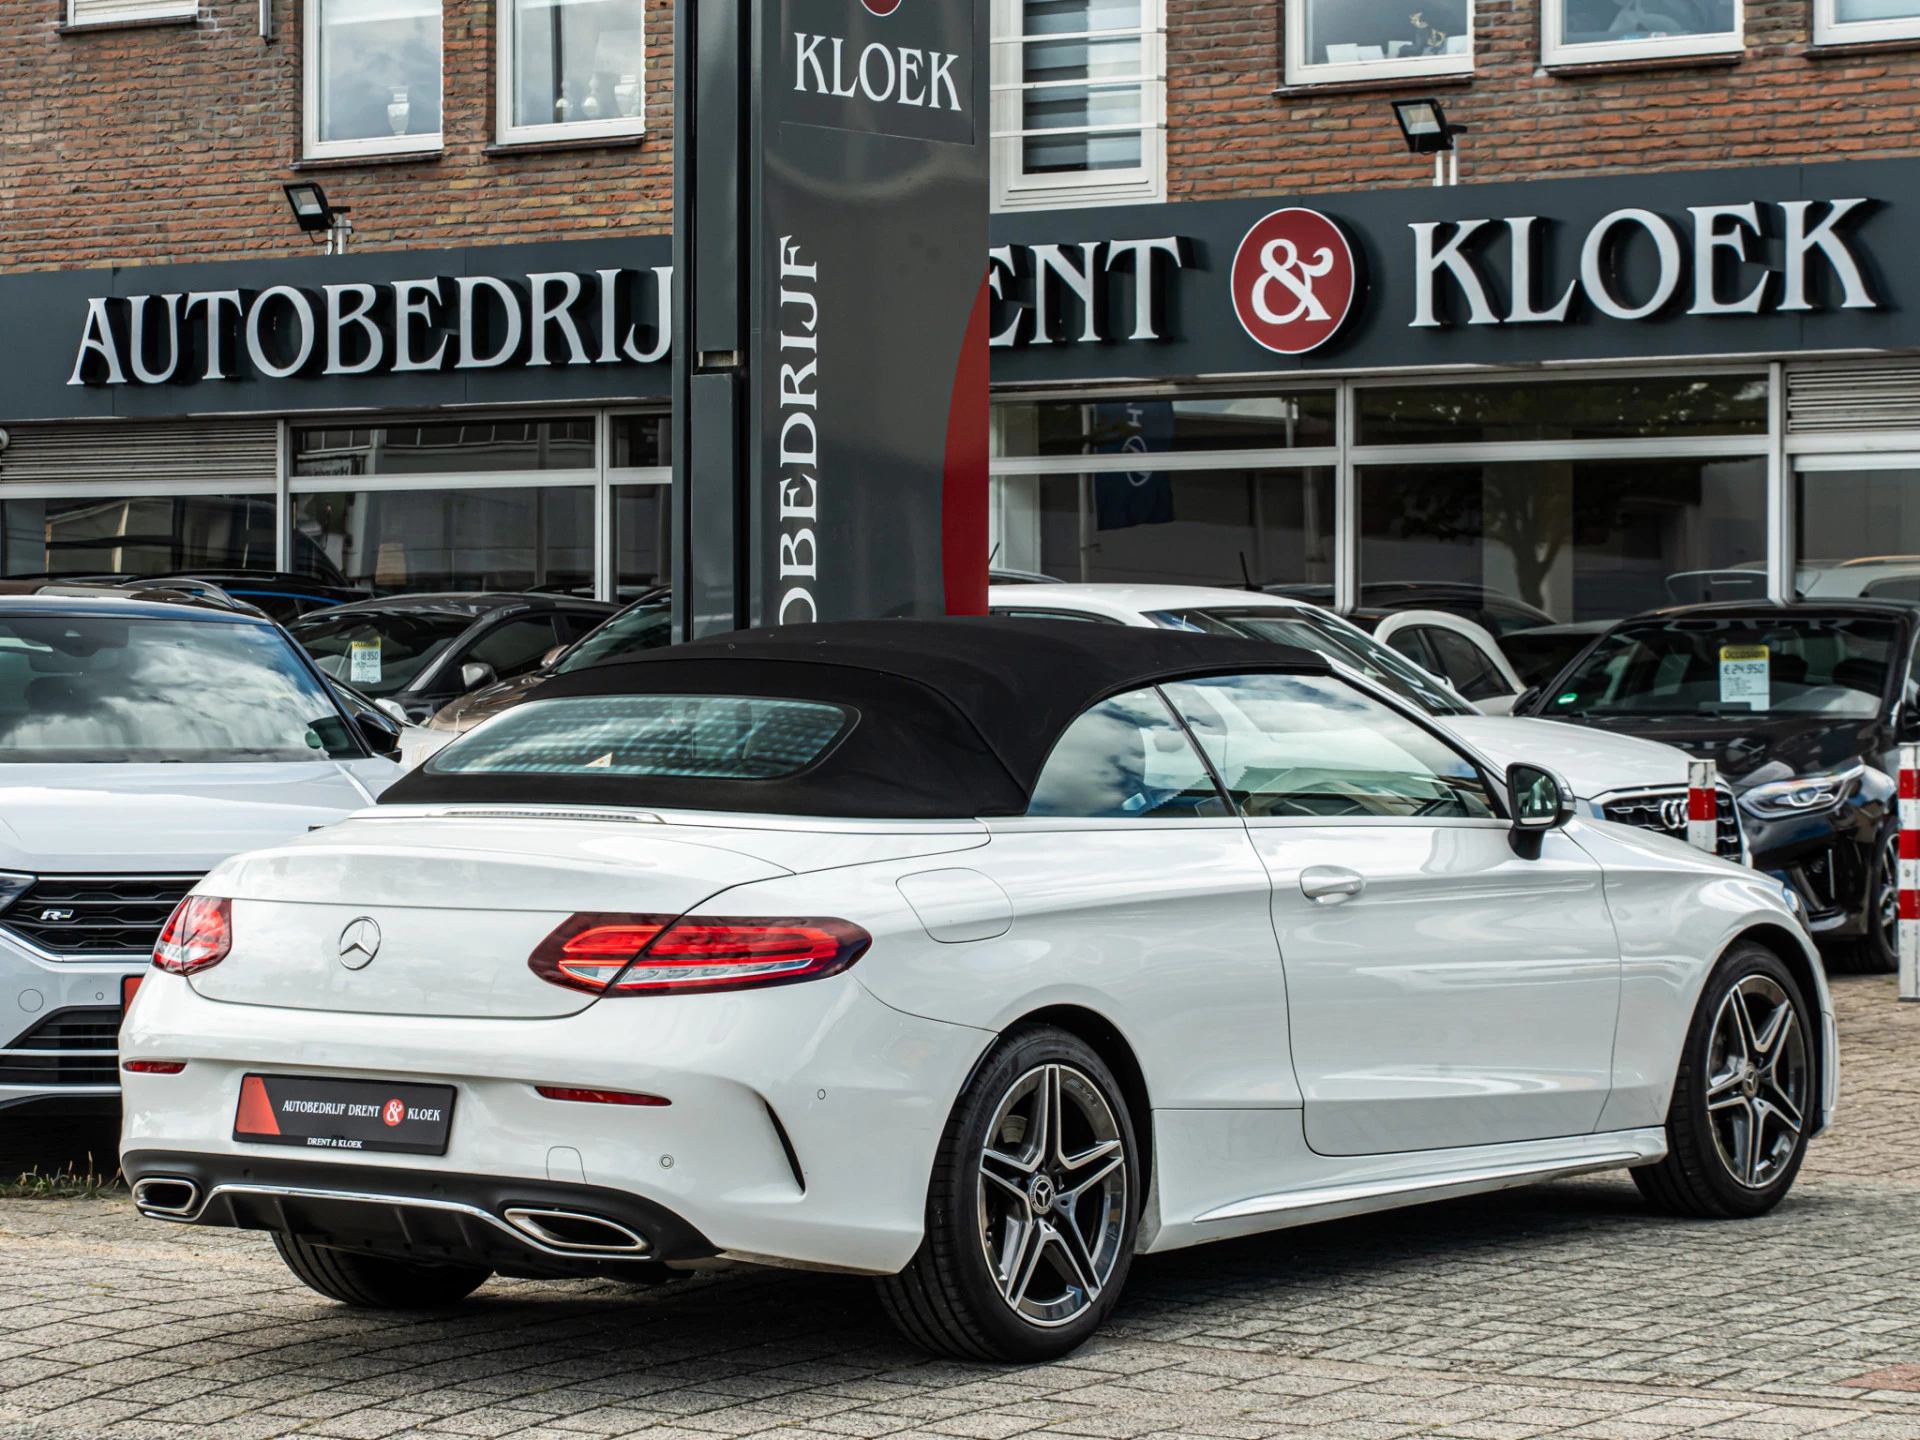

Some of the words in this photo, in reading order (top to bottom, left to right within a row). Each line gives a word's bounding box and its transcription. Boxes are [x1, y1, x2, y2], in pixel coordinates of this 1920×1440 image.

[793, 32, 962, 112] KLOEK
[1251, 238, 1333, 324] &
[1408, 197, 1877, 328] KLOEK
[282, 1099, 346, 1116] AUTOBEDRIJF
[347, 1104, 381, 1118] DRENT
[386, 1101, 402, 1122] &
[407, 1108, 441, 1122] KLOEK
[307, 1137, 331, 1147] DRENT
[338, 1140, 362, 1149] KLOEK
